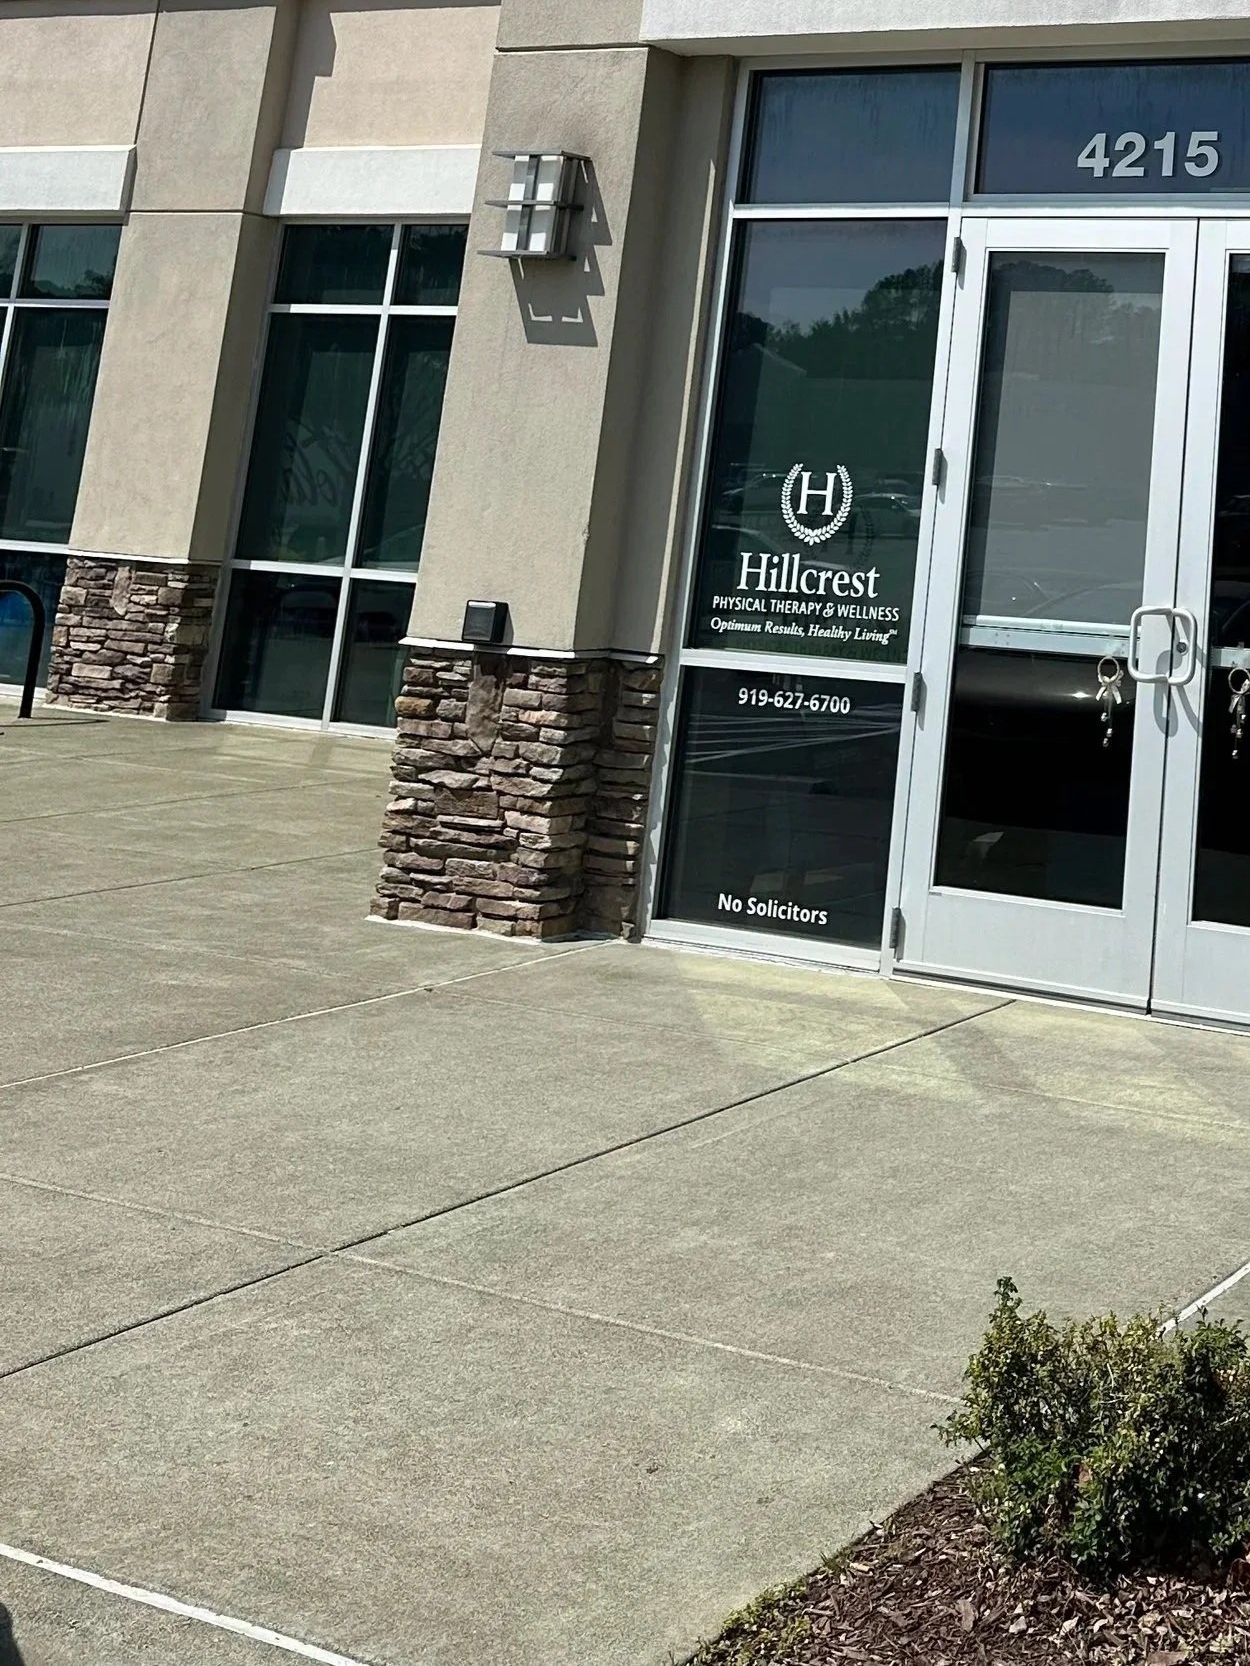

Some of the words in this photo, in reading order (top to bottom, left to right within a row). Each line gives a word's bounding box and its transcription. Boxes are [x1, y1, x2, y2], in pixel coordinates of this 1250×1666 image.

[1077, 131, 1220, 177] 4215
[797, 471, 837, 516] H
[737, 552, 880, 599] Hillcrest
[712, 595, 767, 612] PHYSICAL
[770, 599, 822, 616] THERAPY
[822, 602, 835, 618] &
[837, 604, 900, 621] WELLNESS
[710, 616, 762, 633] Optimum
[764, 620, 806, 638] Results,
[807, 624, 852, 642] Healthy
[738, 687, 851, 714] 919-627-6700
[717, 892, 743, 912] No
[746, 897, 828, 925] Solicitors
